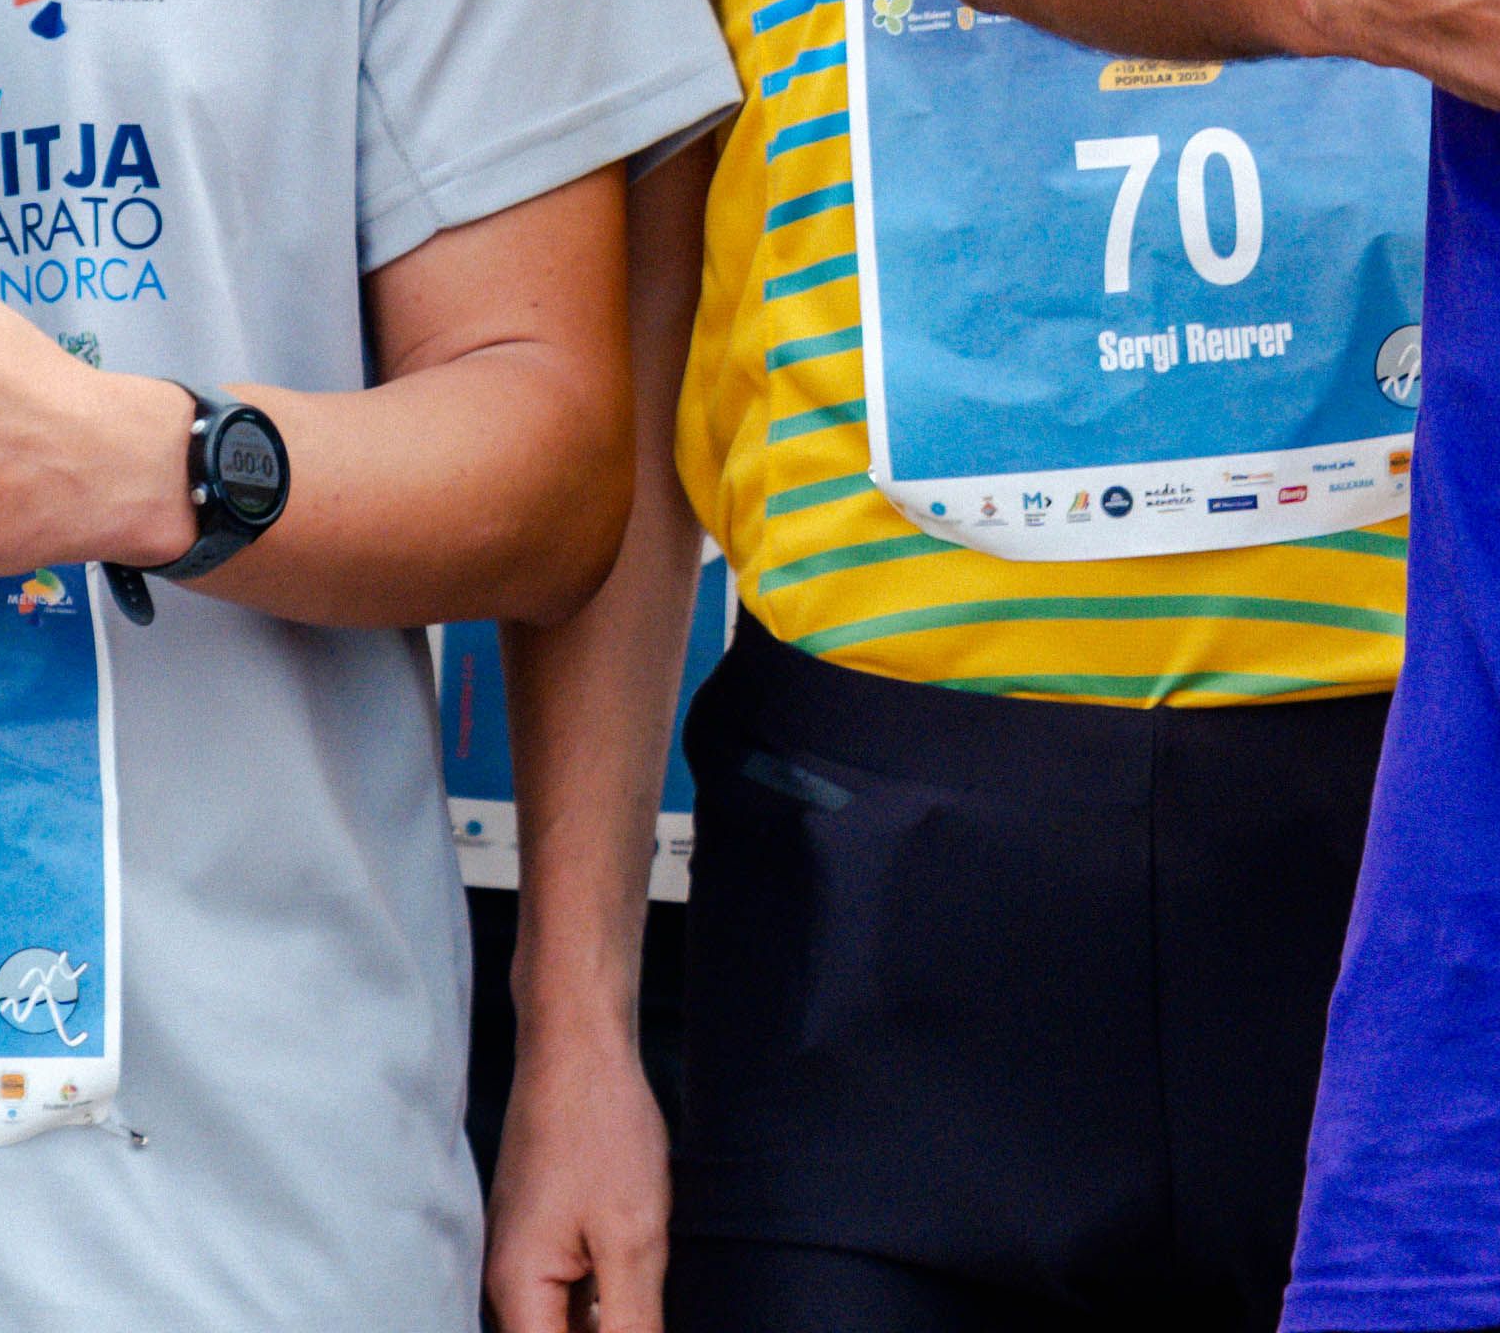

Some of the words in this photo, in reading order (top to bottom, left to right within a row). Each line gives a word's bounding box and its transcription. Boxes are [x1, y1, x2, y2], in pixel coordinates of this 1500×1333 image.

[1115, 74, 1172, 86] POPULAR
[1075, 127, 1264, 295] 70
[1099, 325, 1180, 375] Sergi
[1186, 322, 1293, 367] Reurer
